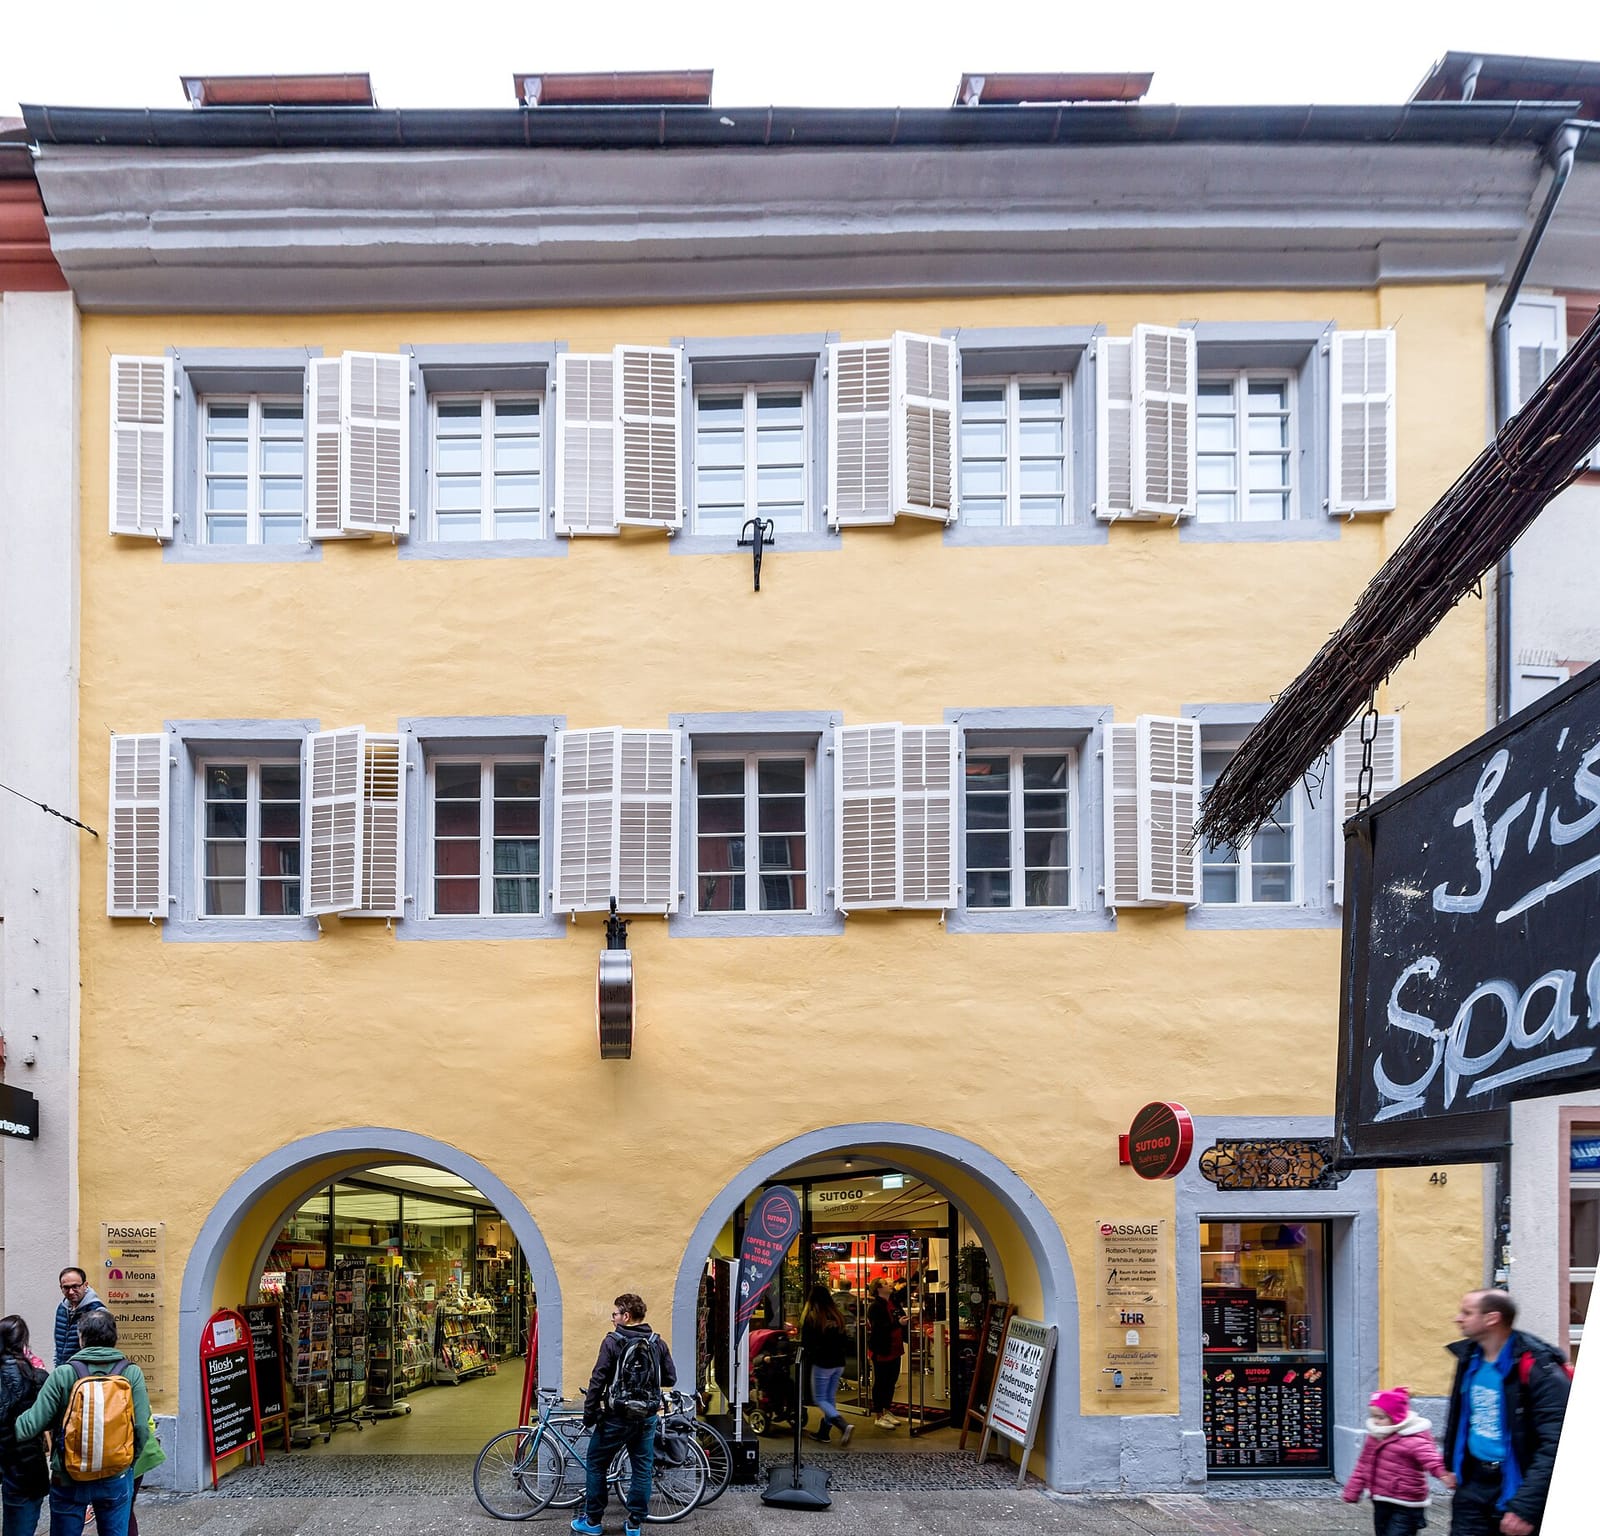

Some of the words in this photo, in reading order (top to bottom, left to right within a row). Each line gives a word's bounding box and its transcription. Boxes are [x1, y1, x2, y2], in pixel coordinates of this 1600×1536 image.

[1373, 953, 1600, 1110] Spa
[1135, 1136, 1171, 1152] SUTOGO
[1429, 1172, 1448, 1185] 48
[819, 1189, 863, 1202] SUTOGO
[767, 1214, 787, 1224] SUTOGO
[107, 1227, 157, 1238] PASSAGE
[1111, 1225, 1158, 1235] ASSAGE
[747, 1237, 766, 1248] COFFEE
[772, 1242, 783, 1251] TEA
[762, 1248, 770, 1257] GO
[1105, 1247, 1157, 1255] Rotteck-Tiefgarage
[751, 1254, 773, 1267] SUTOGO
[125, 1271, 156, 1280] Meona
[108, 1291, 129, 1299] Eddy's
[114, 1314, 130, 1322] elhi
[131, 1314, 155, 1322] Jeans
[121, 1332, 153, 1340] WILPERT
[209, 1356, 233, 1373] Kiosk
[1003, 1356, 1019, 1371] Eddy's
[998, 1383, 1032, 1408] Schneidere
